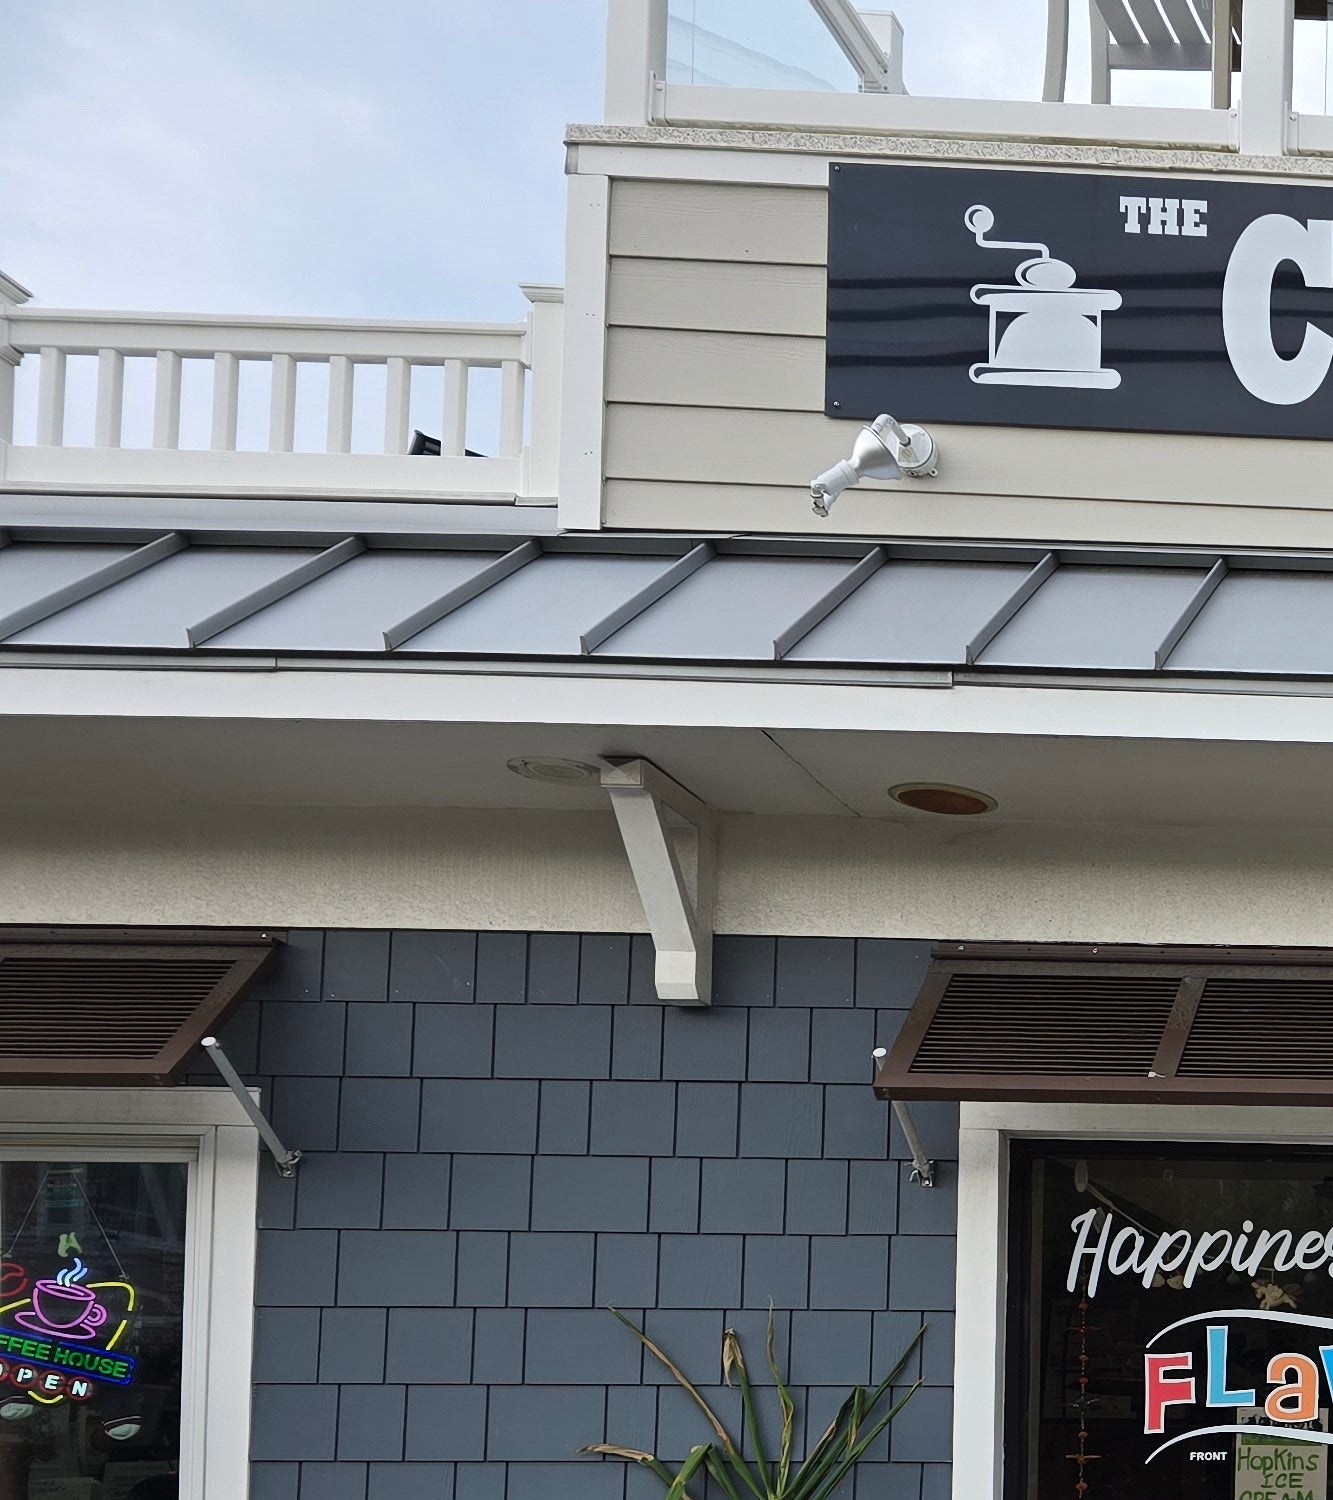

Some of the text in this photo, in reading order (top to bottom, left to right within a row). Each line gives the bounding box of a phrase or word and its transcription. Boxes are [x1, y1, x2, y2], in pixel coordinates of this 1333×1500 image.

[1120, 196, 1208, 238] THE
[53, 1347, 129, 1378] HOUSE
[0, 1363, 88, 1396] PEN
[1189, 1451, 1228, 1461] FRONT
[1261, 1473, 1304, 1488] ICE
